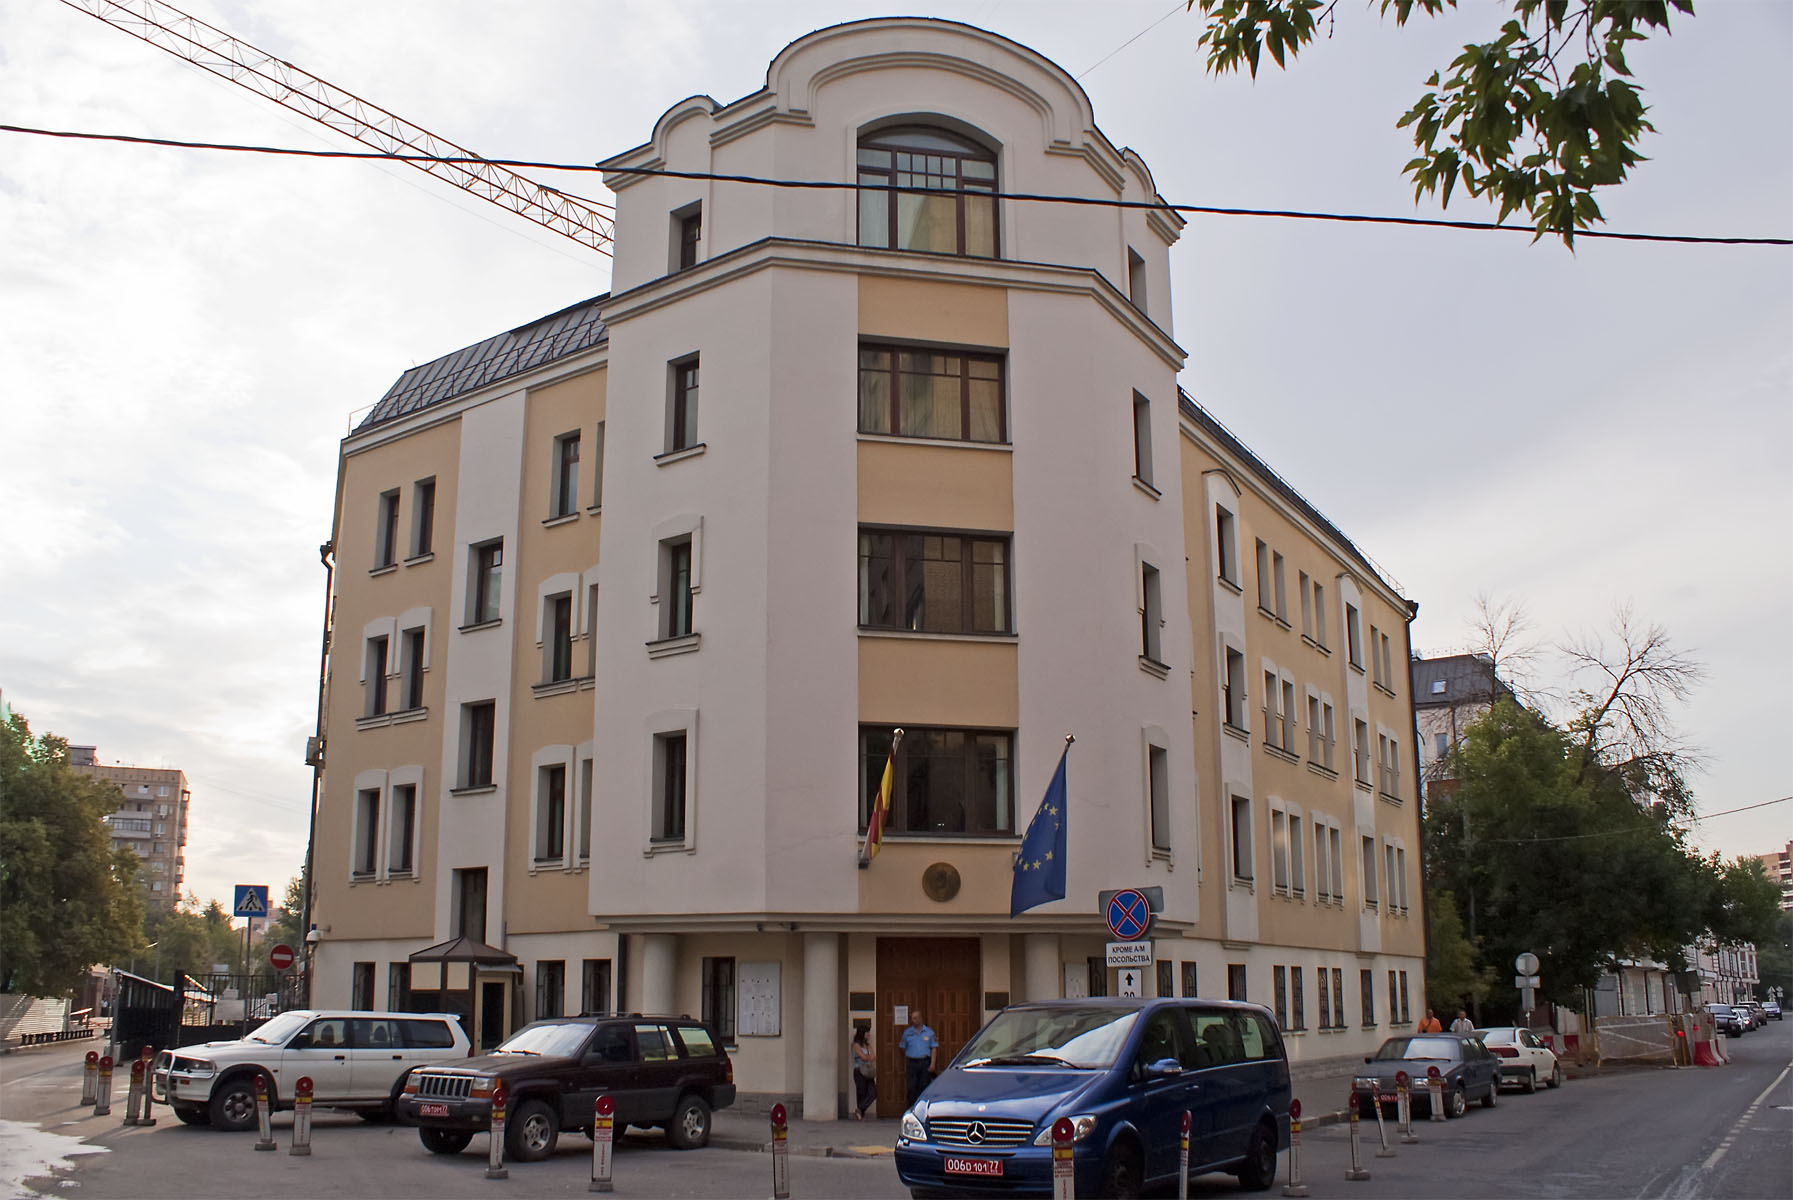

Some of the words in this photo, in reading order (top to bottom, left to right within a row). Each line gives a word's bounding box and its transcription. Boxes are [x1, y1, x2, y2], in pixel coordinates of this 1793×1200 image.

[1112, 945, 1133, 954] КРОМЕ
[1134, 945, 1145, 953] А/М
[1108, 954, 1150, 964] ПОСОЛЬСТВА
